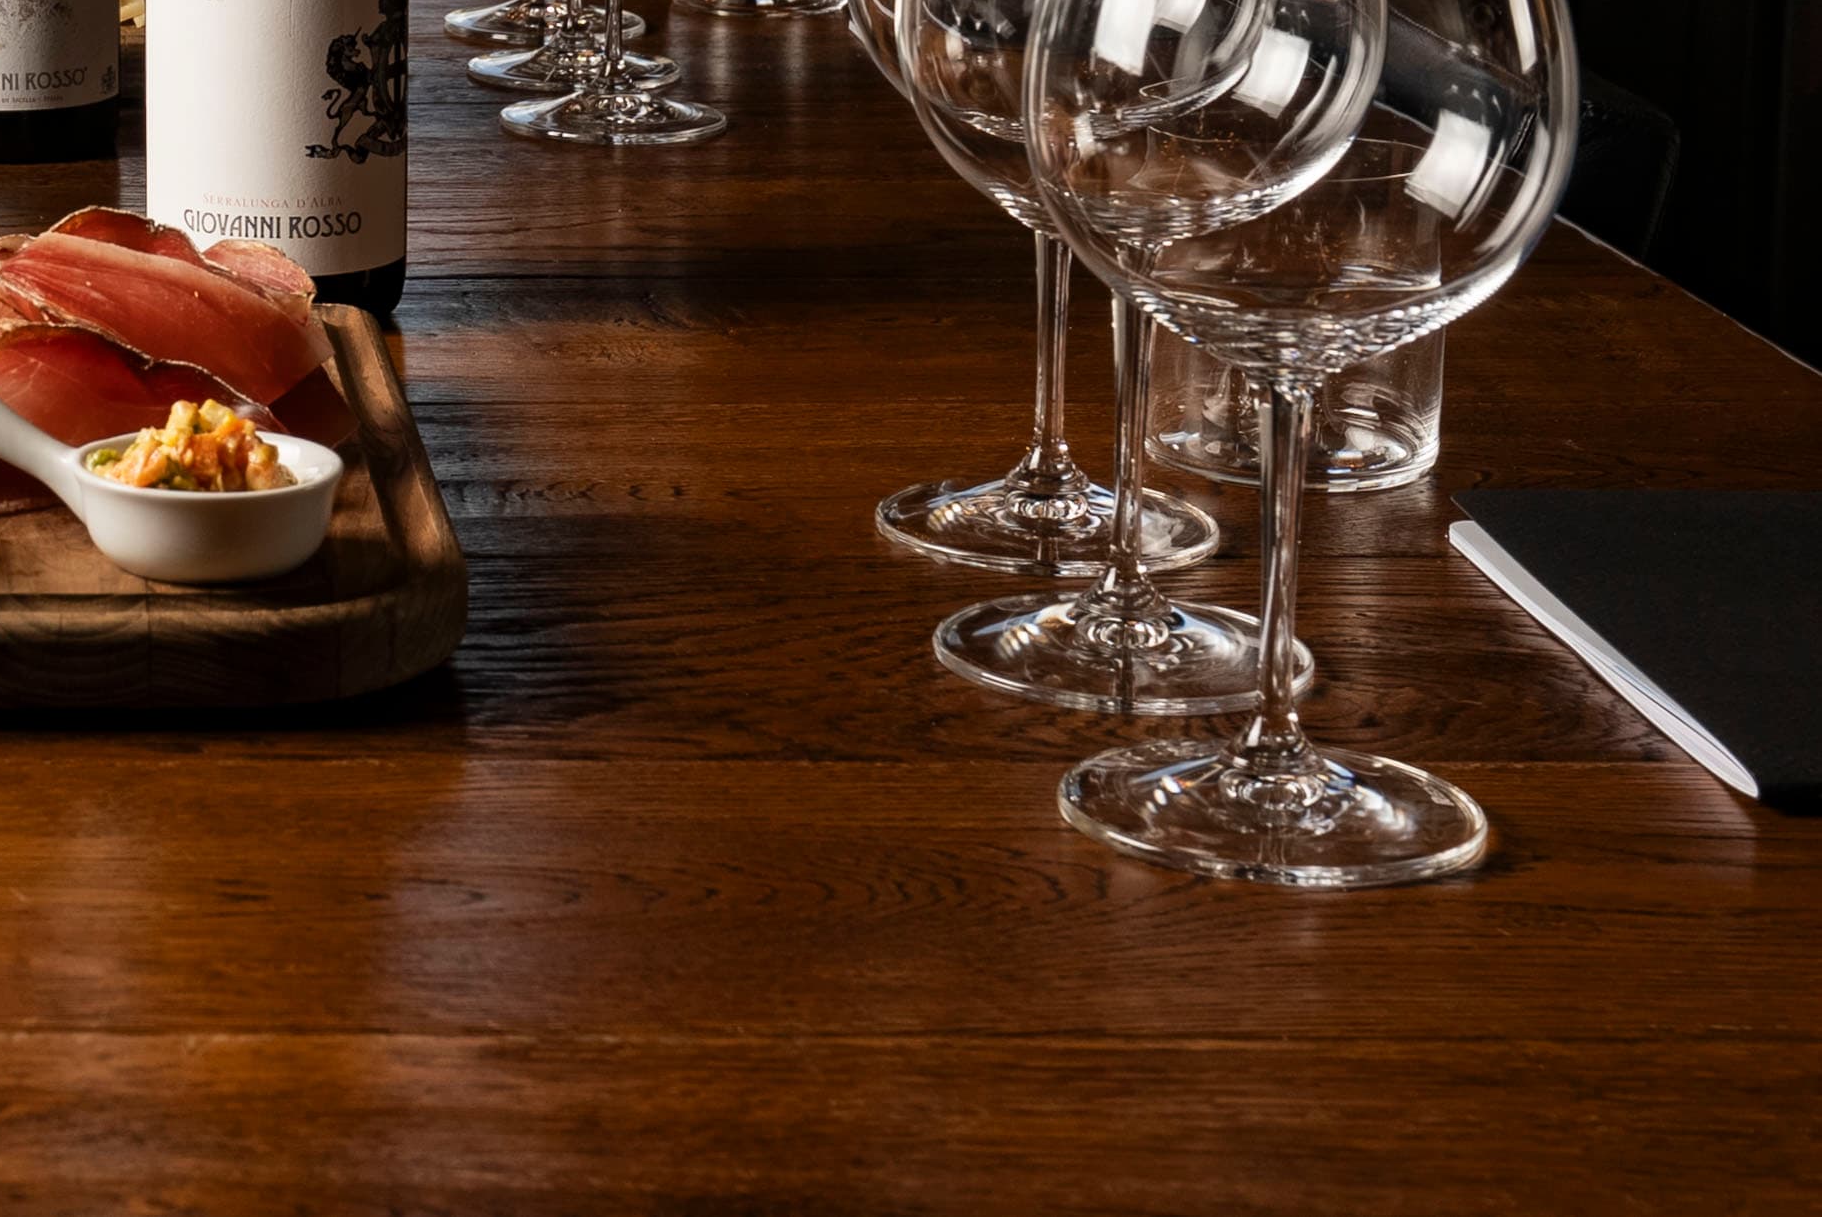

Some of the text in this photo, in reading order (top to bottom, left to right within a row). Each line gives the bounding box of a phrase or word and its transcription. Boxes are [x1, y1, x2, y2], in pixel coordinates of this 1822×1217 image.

[25, 68, 85, 90] ROSSO
[202, 193, 289, 209] SERRALUNGA
[183, 208, 362, 239] GIOVANNI ROSSO
